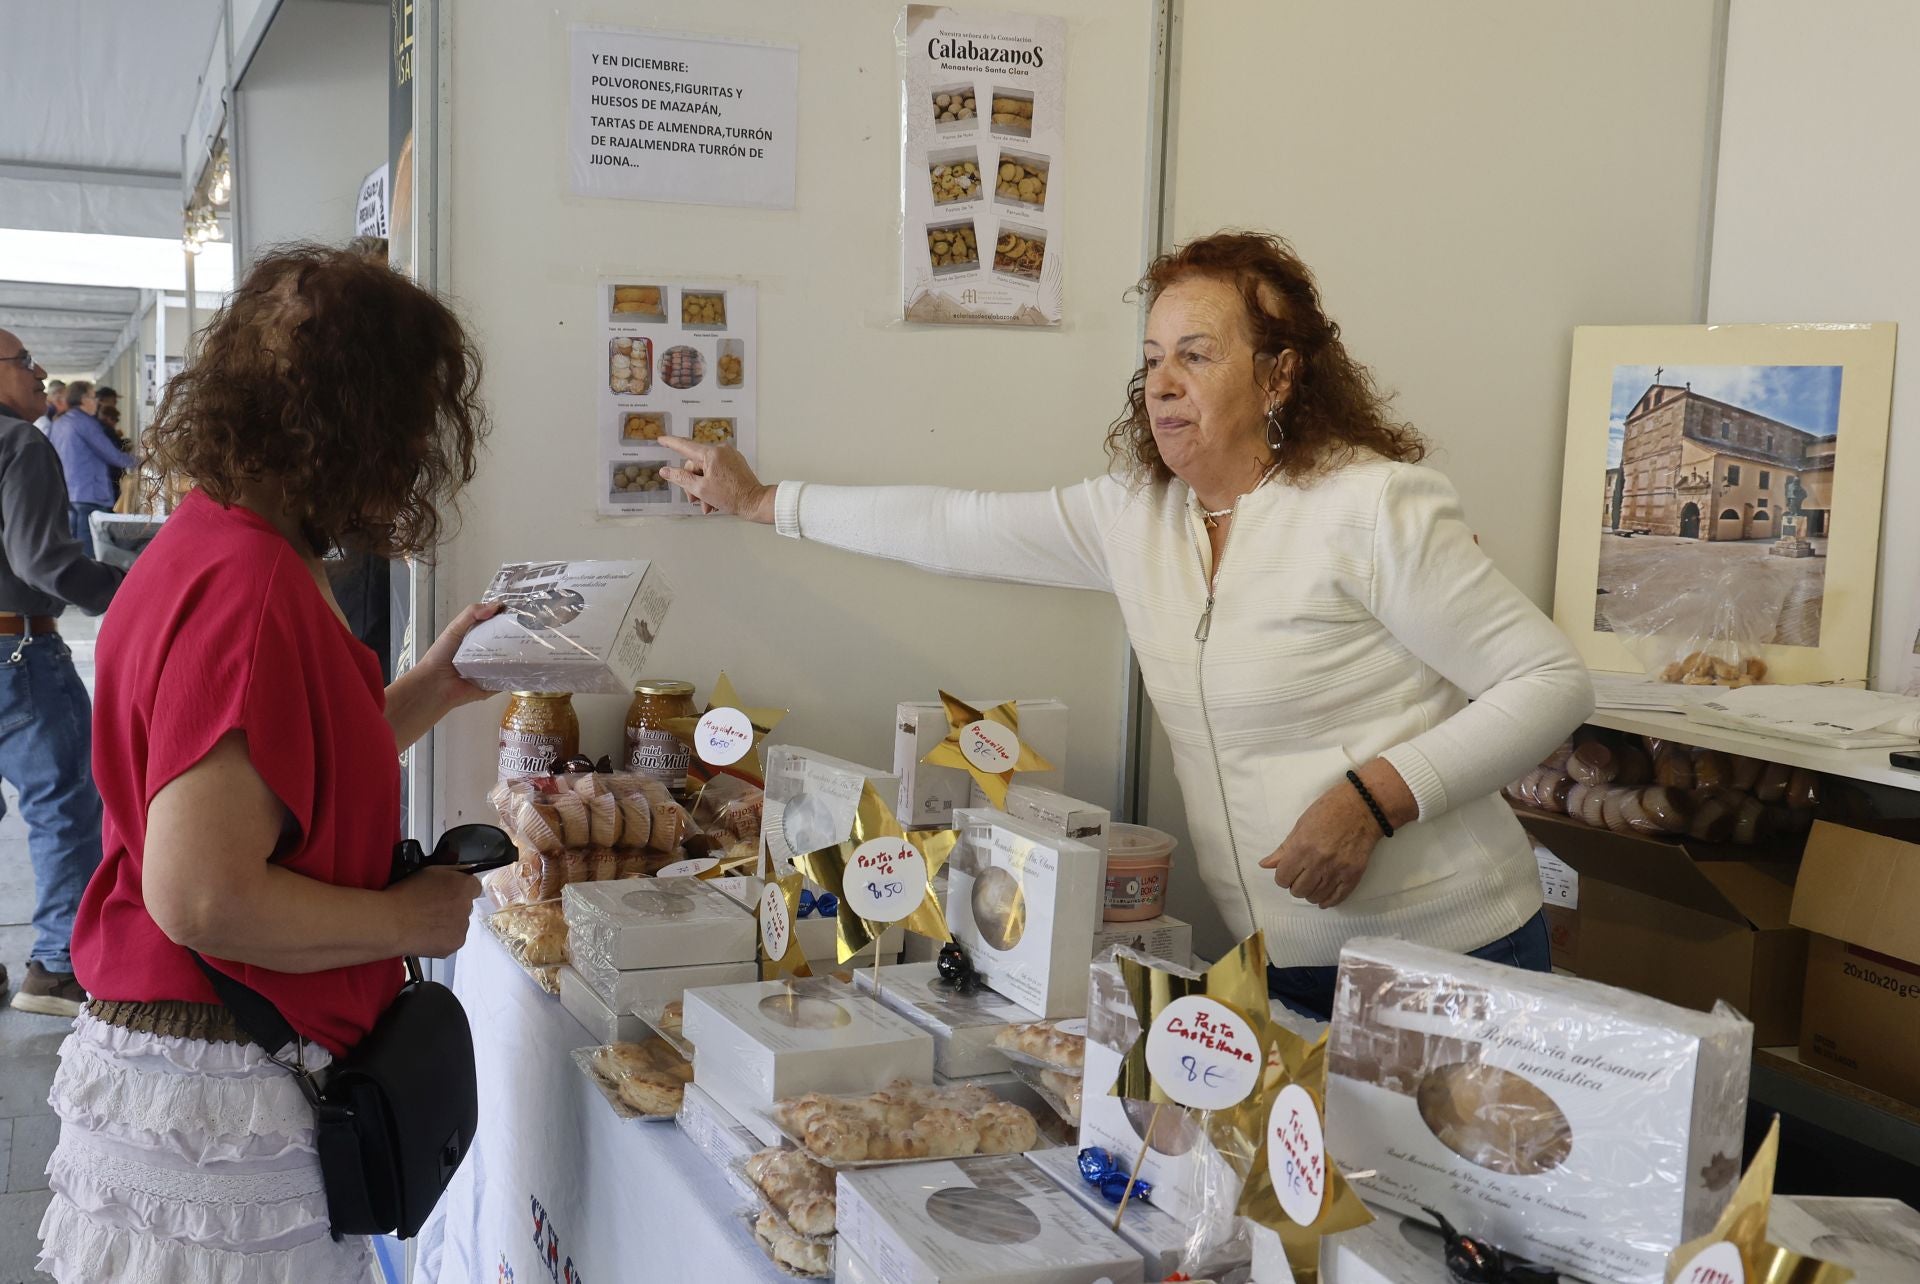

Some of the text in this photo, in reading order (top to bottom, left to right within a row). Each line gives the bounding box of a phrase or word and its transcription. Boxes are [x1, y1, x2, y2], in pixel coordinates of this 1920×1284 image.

[939, 30, 962, 38] Nuestra
[962, 31, 982, 39] señora
[982, 32, 990, 40] de
[990, 33, 997, 41] la
[592, 53, 689, 73] Y EN DICIEMBRE:
[941, 62, 1029, 75] Monasterio Santa Clara
[591, 75, 743, 99] POLVORONES,FIGURITAS Y
[591, 94, 722, 117] HUESOS DE MAZAPÁN,
[591, 115, 773, 141] TARTAS DE ALMENDRA,TURRÓN
[591, 135, 764, 159] DE RAJALMENDRA TURRÓN DE
[590, 153, 640, 168] JIJONA...
[499, 750, 518, 769] San
[632, 751, 660, 768] San
[641, 744, 662, 756] miel
[858, 844, 914, 868] Pastas de
[1548, 887, 1567, 898] 2 C
[1843, 962, 1898, 992] 20x10x20
[1898, 984, 1907, 998] g
[1195, 1011, 1234, 1039] Pasta
[1475, 1024, 1664, 1083] Repostería artesanal
[1516, 1060, 1605, 1092] monástica
